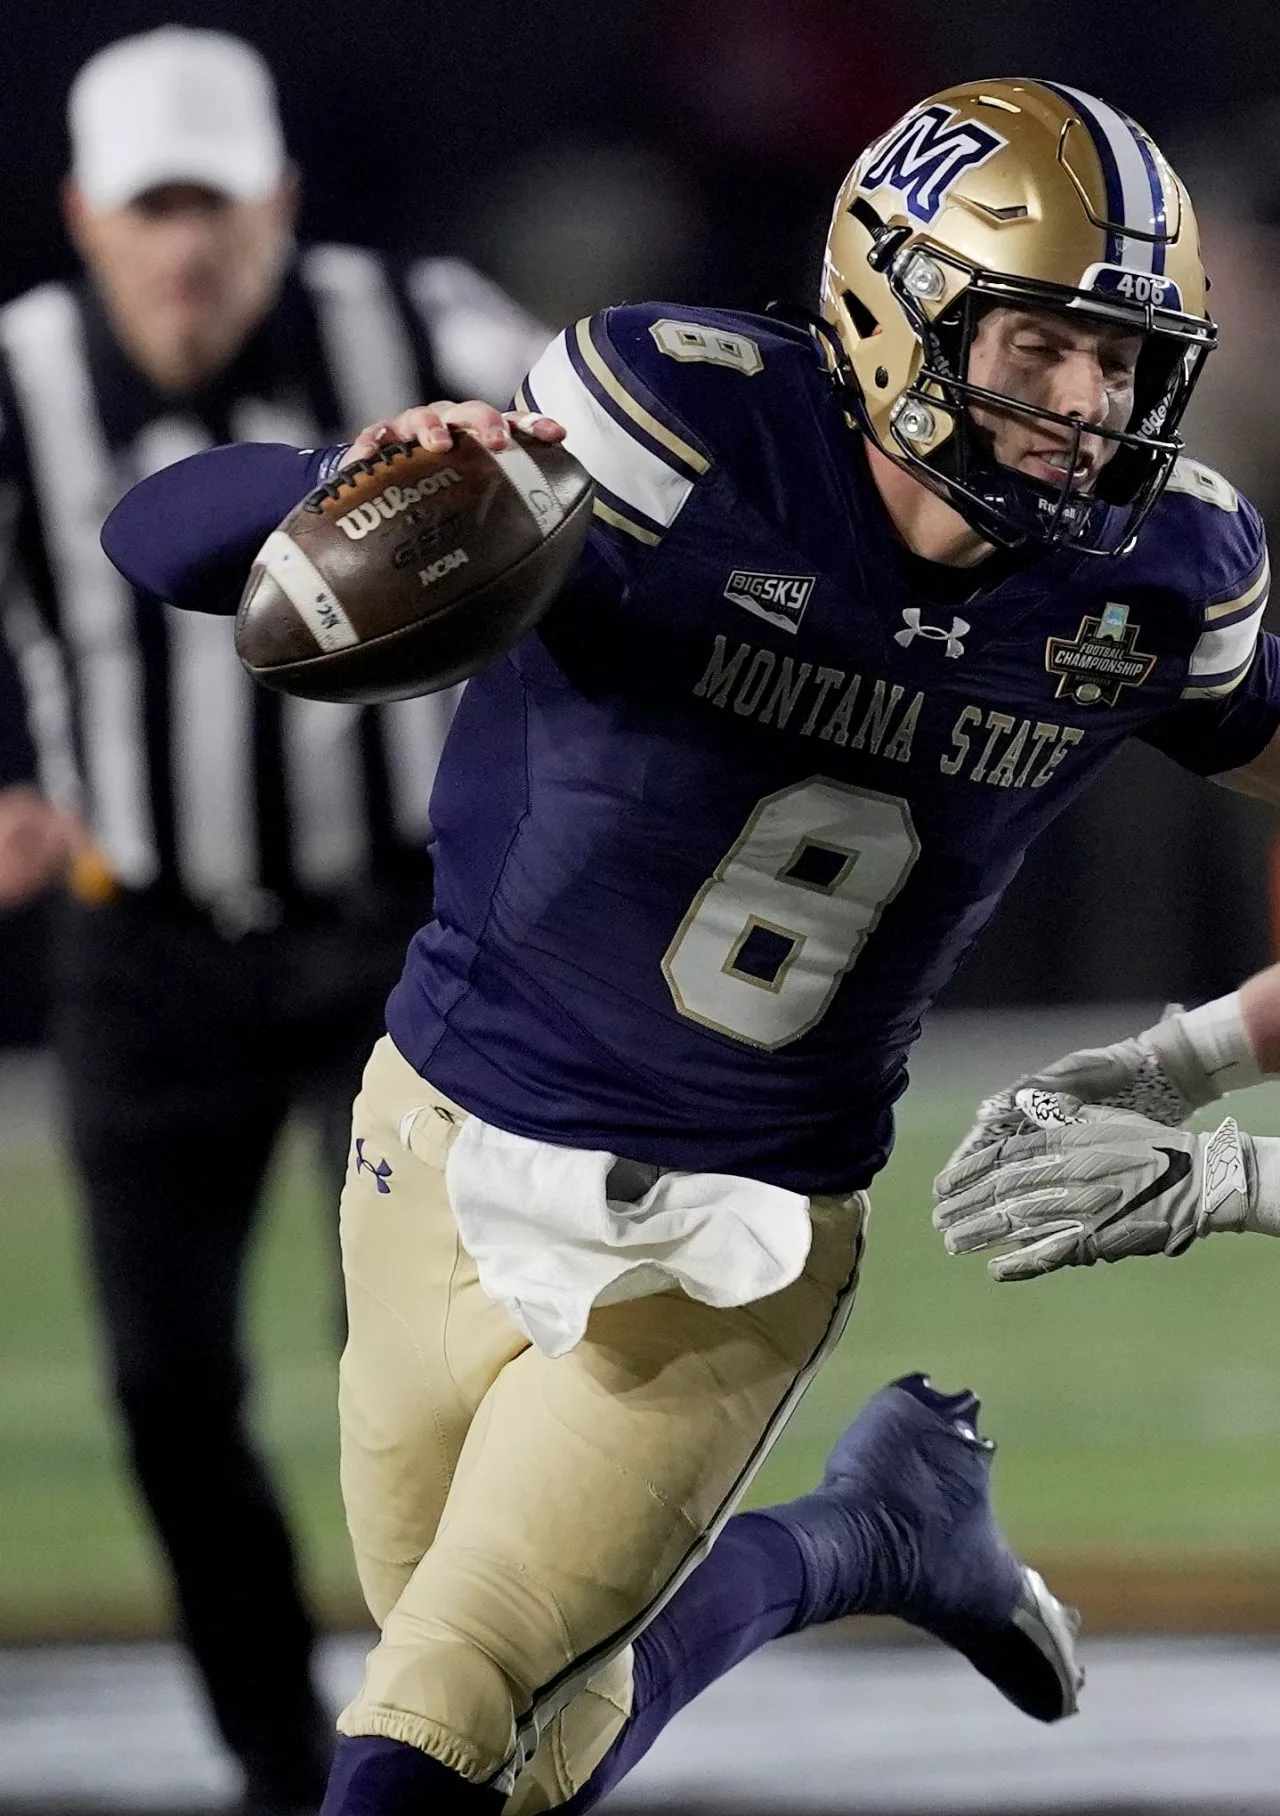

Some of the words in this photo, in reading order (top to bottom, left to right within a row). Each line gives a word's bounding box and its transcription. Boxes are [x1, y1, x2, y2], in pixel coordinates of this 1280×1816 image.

[856, 103, 1009, 229] M
[1116, 273, 1166, 306] 406
[648, 318, 764, 376] 8
[336, 468, 462, 540] Wilson
[1054, 650, 1144, 677] CHAMPIONSHIP
[1080, 642, 1125, 661] FOOTBALL
[693, 634, 925, 763] MONTANA
[940, 705, 1084, 789] STATE
[661, 774, 921, 1053] 8
